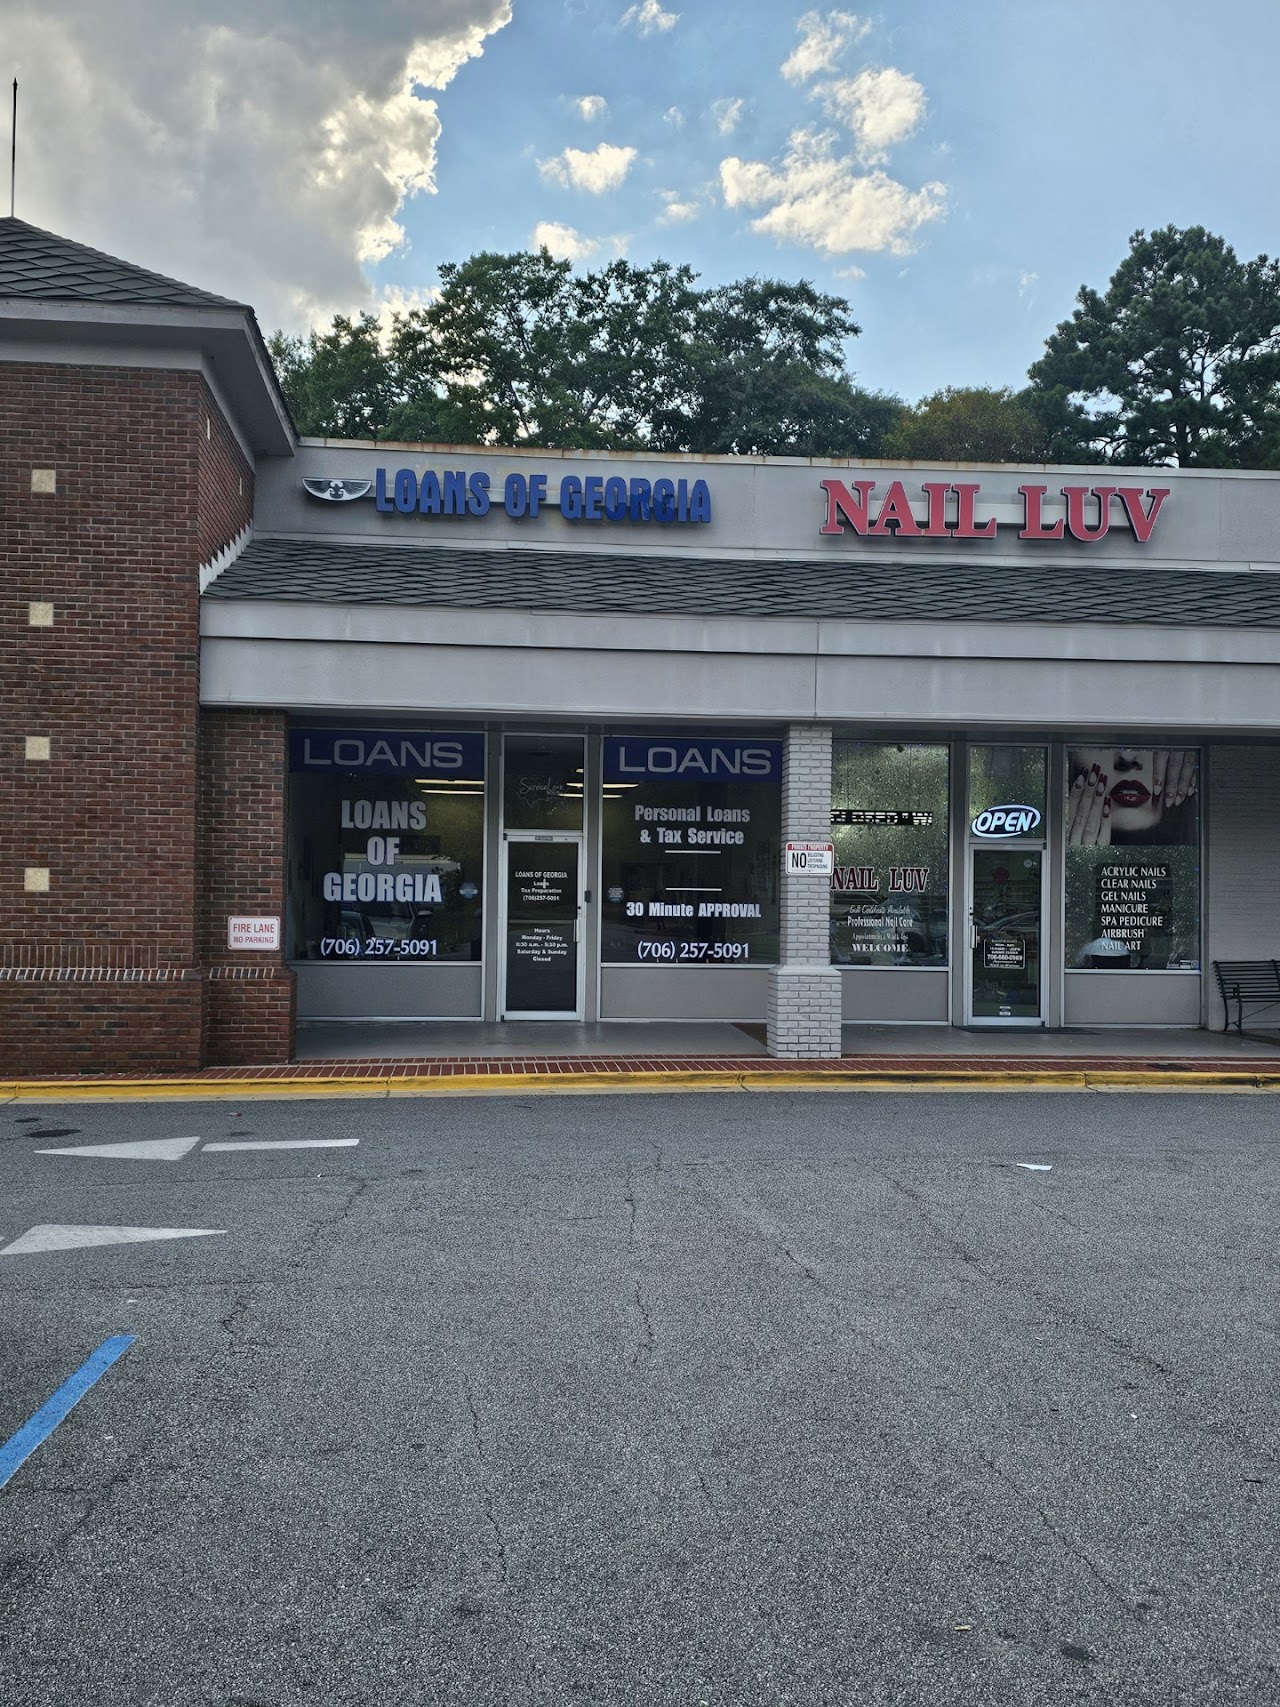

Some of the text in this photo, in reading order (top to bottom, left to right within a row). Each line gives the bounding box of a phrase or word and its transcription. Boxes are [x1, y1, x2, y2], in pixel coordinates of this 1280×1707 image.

[375, 468, 711, 524] LOANS OF GEORGIA
[820, 479, 1171, 542] NAIL LUV
[304, 738, 463, 768] LOANS
[619, 746, 772, 775] LOANS
[341, 800, 427, 830] LOANS
[635, 804, 750, 822] Personal Loans
[976, 811, 1033, 832] OPEN
[640, 827, 744, 845] & Tax Service
[366, 836, 400, 866] OF
[792, 852, 807, 868] NO
[830, 866, 929, 892] NAIL LUV
[1101, 866, 1167, 877] ACRYLIC NAILS
[323, 872, 442, 903] GEORGIA
[1101, 879, 1157, 889] CLEAR NAILS
[1101, 891, 1146, 901] GEL NAILS
[626, 902, 762, 918] 30 Minute APPROVAL
[1101, 903, 1148, 914] MANICURE
[233, 923, 275, 933] FIRE LANE
[847, 916, 913, 927] Professional Nail Care
[1101, 916, 1163, 926] SPA PEDICURE
[1101, 928, 1145, 938] AIRBRUSH
[320, 937, 437, 956] (706) 257-5091
[637, 941, 749, 959] (706) 257-5091
[852, 944, 909, 952] WELCOME
[1101, 941, 1141, 950] NAIL ART
